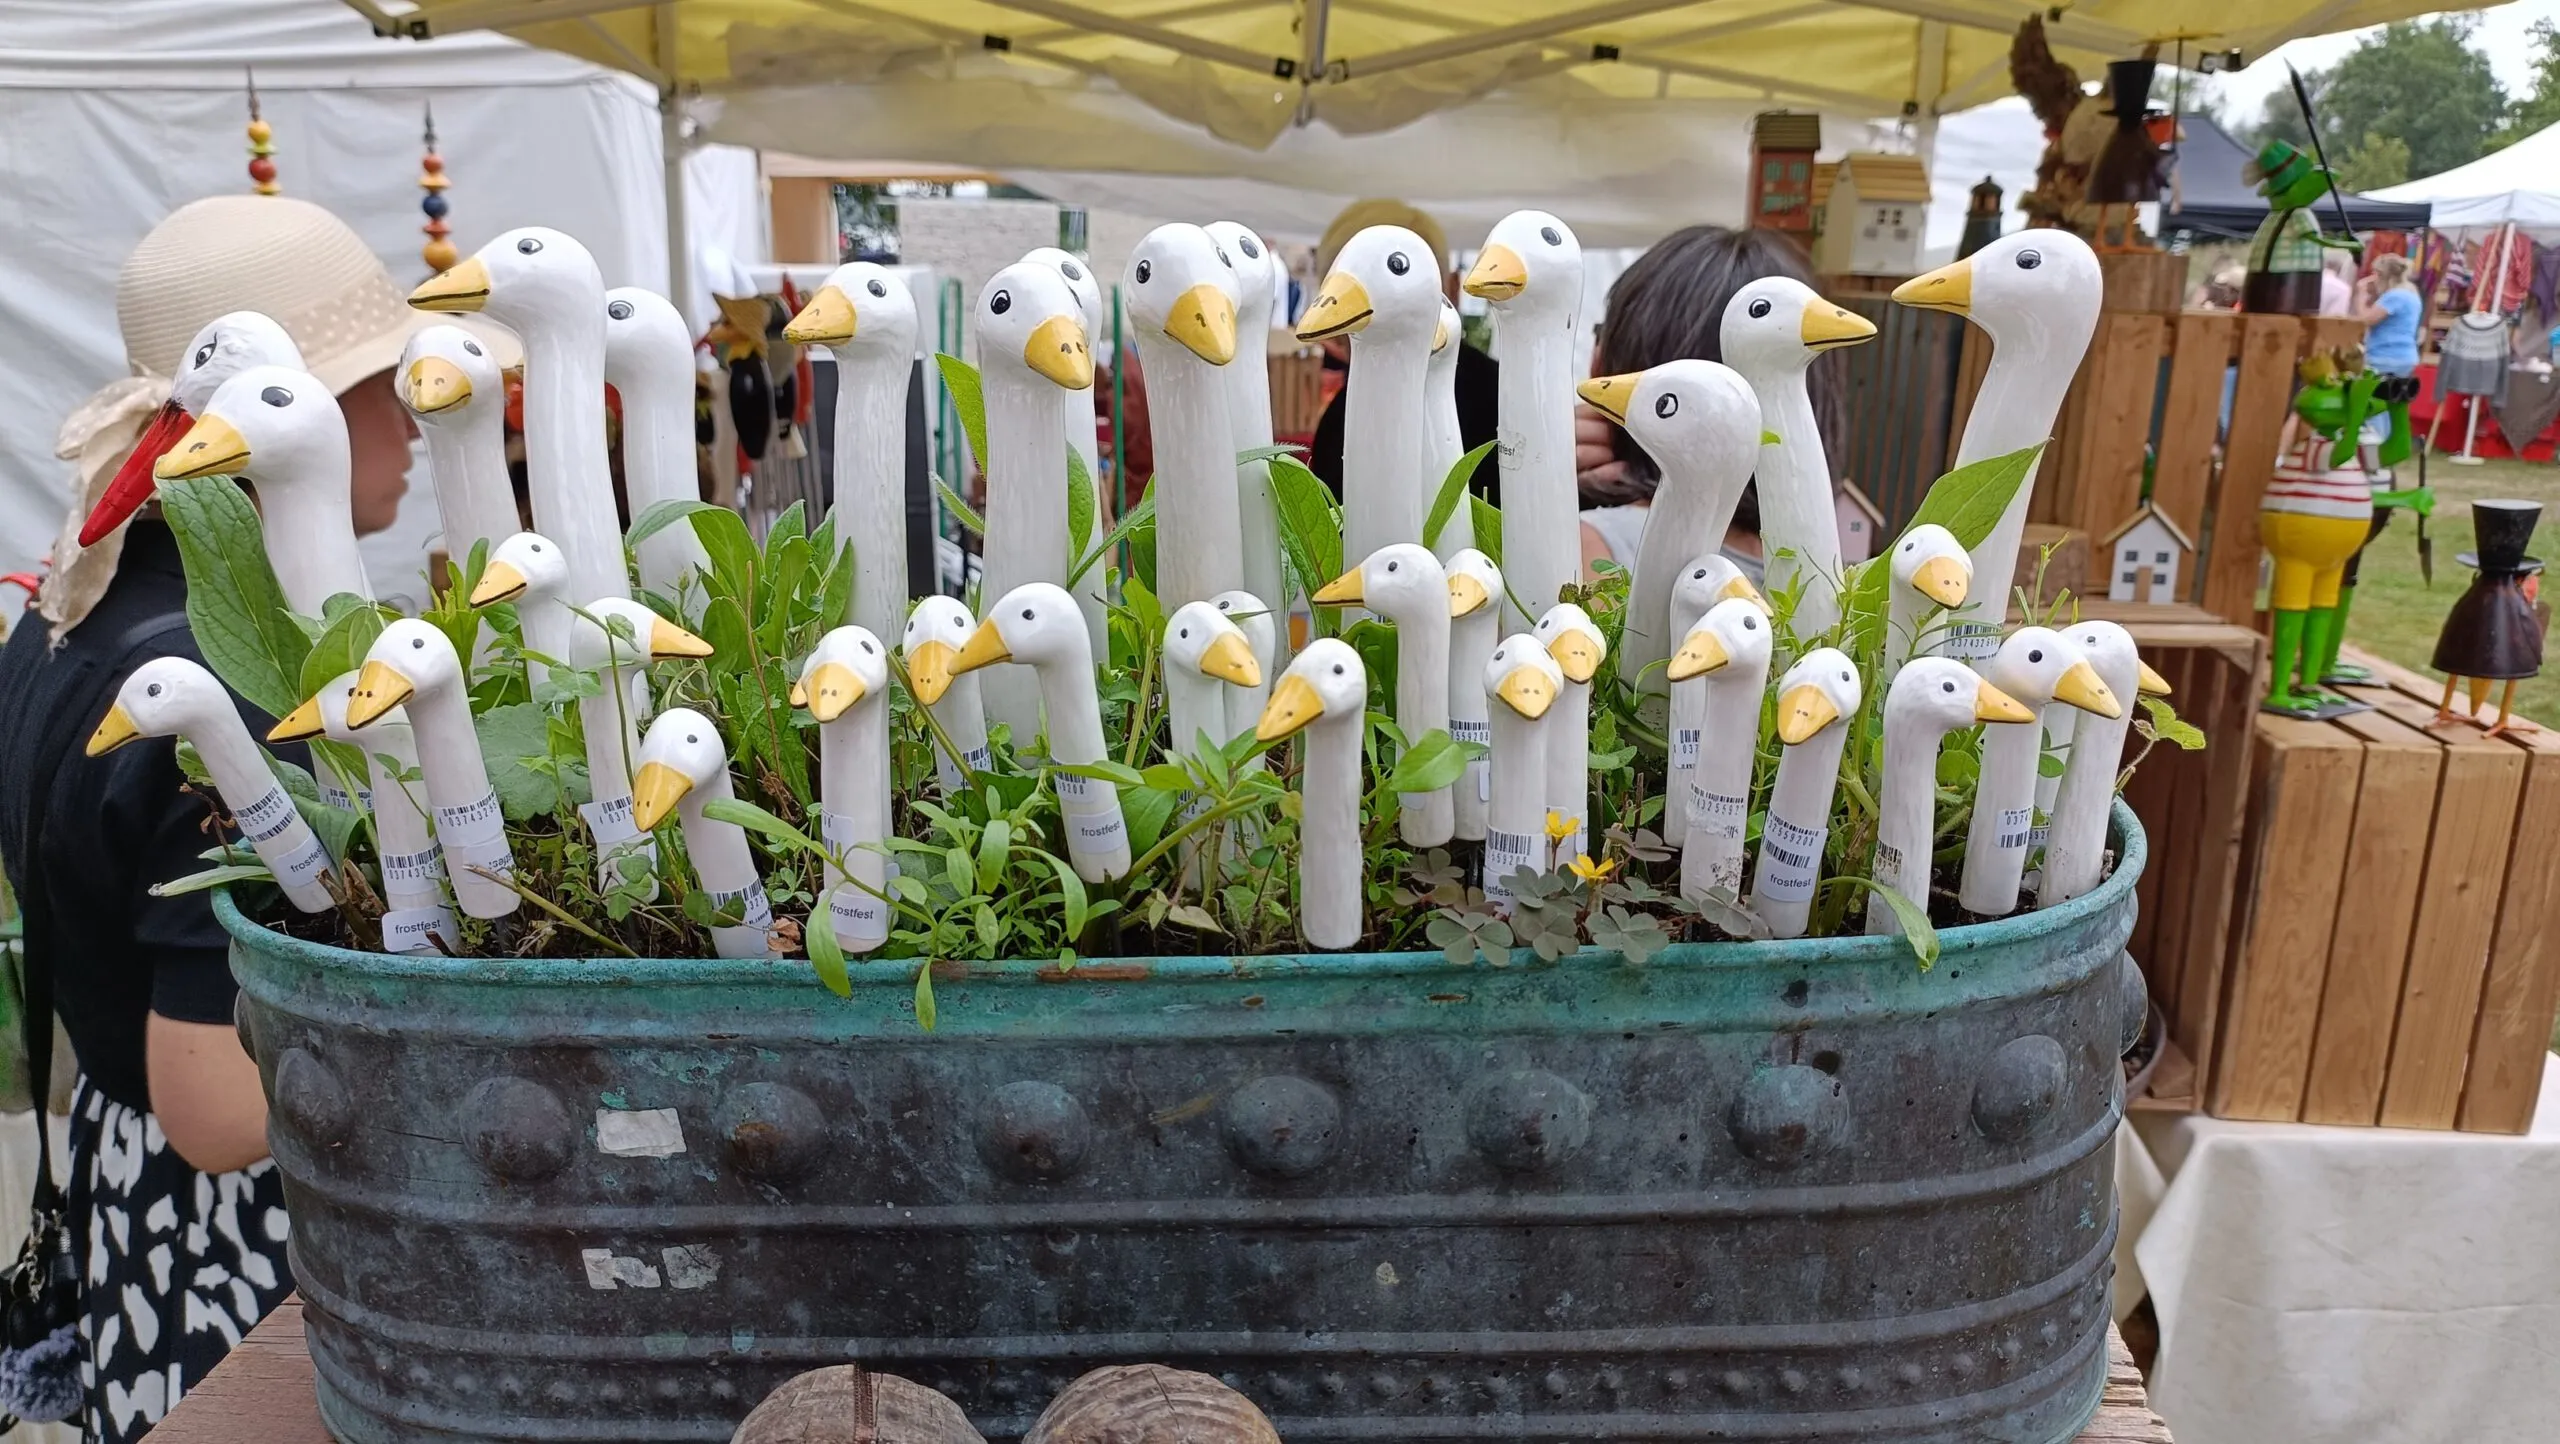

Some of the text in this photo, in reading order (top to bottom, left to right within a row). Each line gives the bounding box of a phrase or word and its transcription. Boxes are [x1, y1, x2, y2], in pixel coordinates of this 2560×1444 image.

[1081, 820, 1121, 837] frostfest
[1770, 872, 1812, 888] frostfest
[829, 902, 875, 920] frostfest
[395, 919, 441, 934] frostfest
